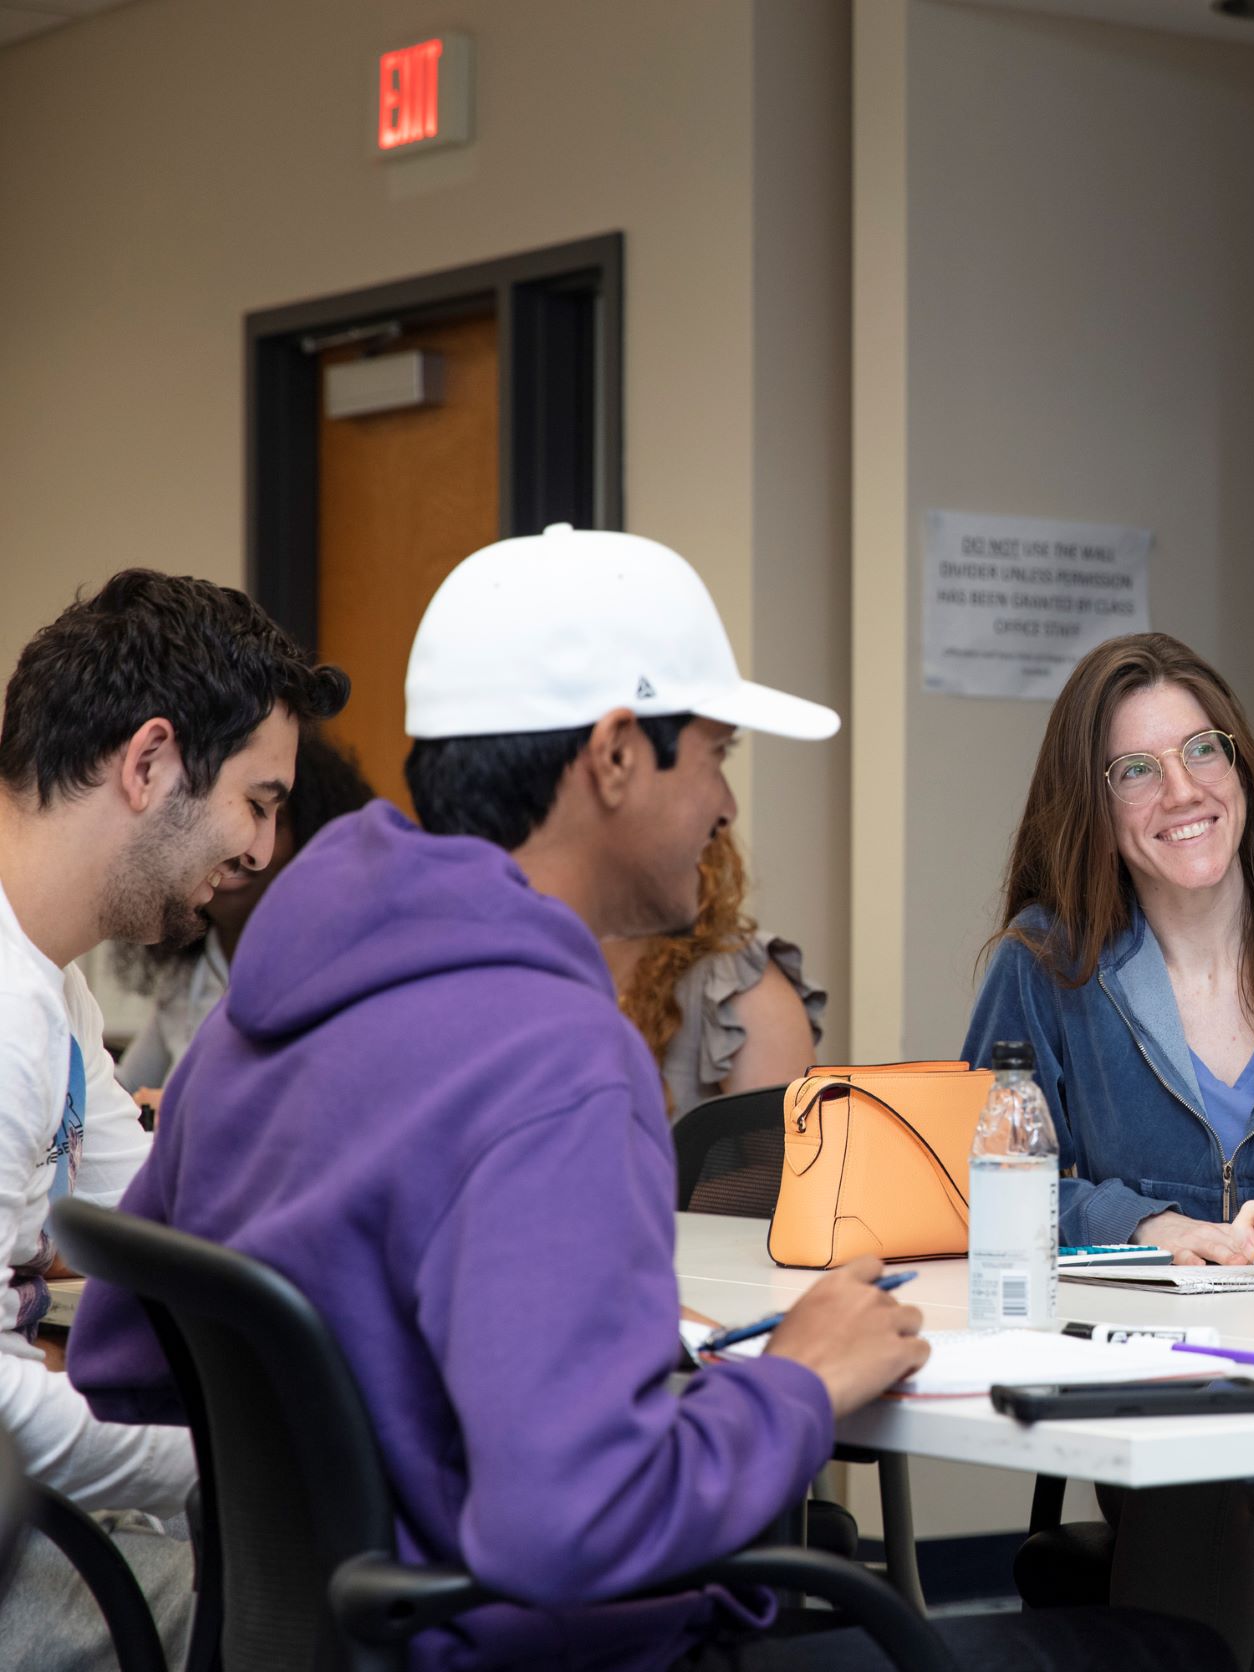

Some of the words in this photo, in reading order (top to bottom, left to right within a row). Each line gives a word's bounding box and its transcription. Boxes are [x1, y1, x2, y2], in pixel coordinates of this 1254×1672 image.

[379, 38, 443, 150] EXIT
[989, 538, 1018, 557] NOT
[1023, 542, 1048, 558] USE
[1055, 543, 1076, 559] THE
[940, 561, 996, 580] DIVIDER
[1002, 567, 1052, 585] UNLESS
[1057, 570, 1133, 589] PERMISSION
[970, 592, 1007, 607] BEEN
[1012, 594, 1071, 611] GRANTED
[1096, 599, 1134, 615] CLASS
[994, 619, 1039, 635] OFFICE
